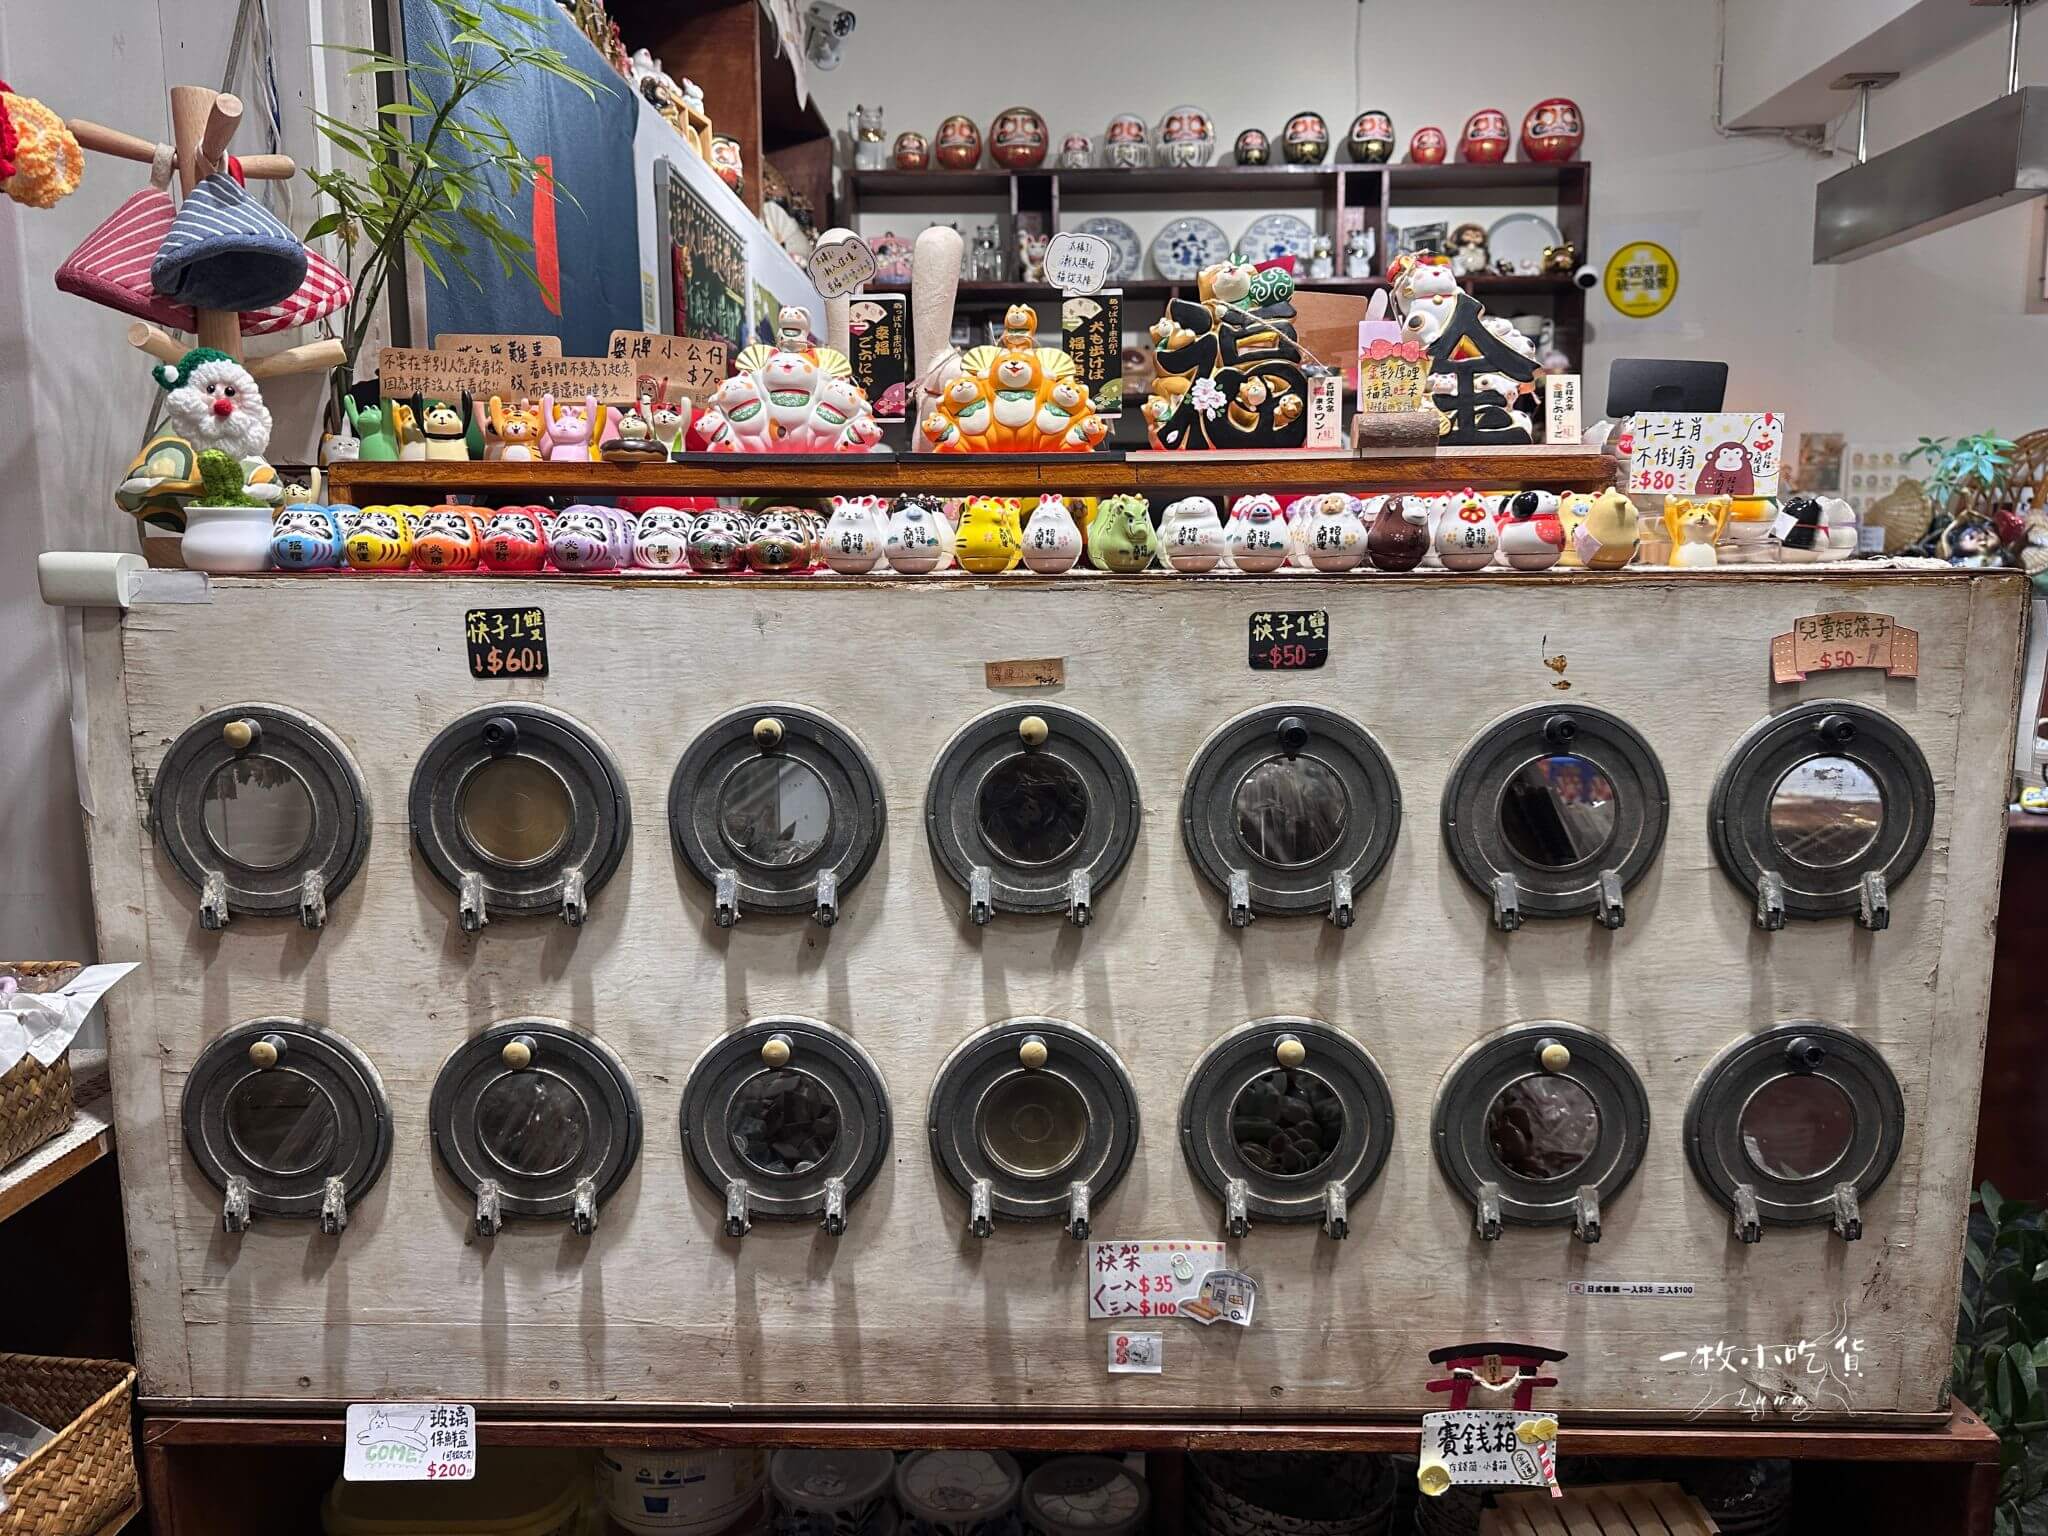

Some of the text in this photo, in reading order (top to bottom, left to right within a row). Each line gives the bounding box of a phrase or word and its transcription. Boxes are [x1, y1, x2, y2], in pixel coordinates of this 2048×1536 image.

[1637, 416, 1702, 442] 十二生肖
[1636, 445, 1695, 470] 不倒翁
[1638, 470, 1675, 490] $80
[466, 609, 544, 644] 筷子1雙
[1799, 614, 1890, 643] 兒童短筷子
[1095, 1243, 1142, 1273] 筷架
[429, 1405, 469, 1428] 玻璃
[430, 1430, 469, 1448] 保鮮盒
[426, 1460, 467, 1480] $200
